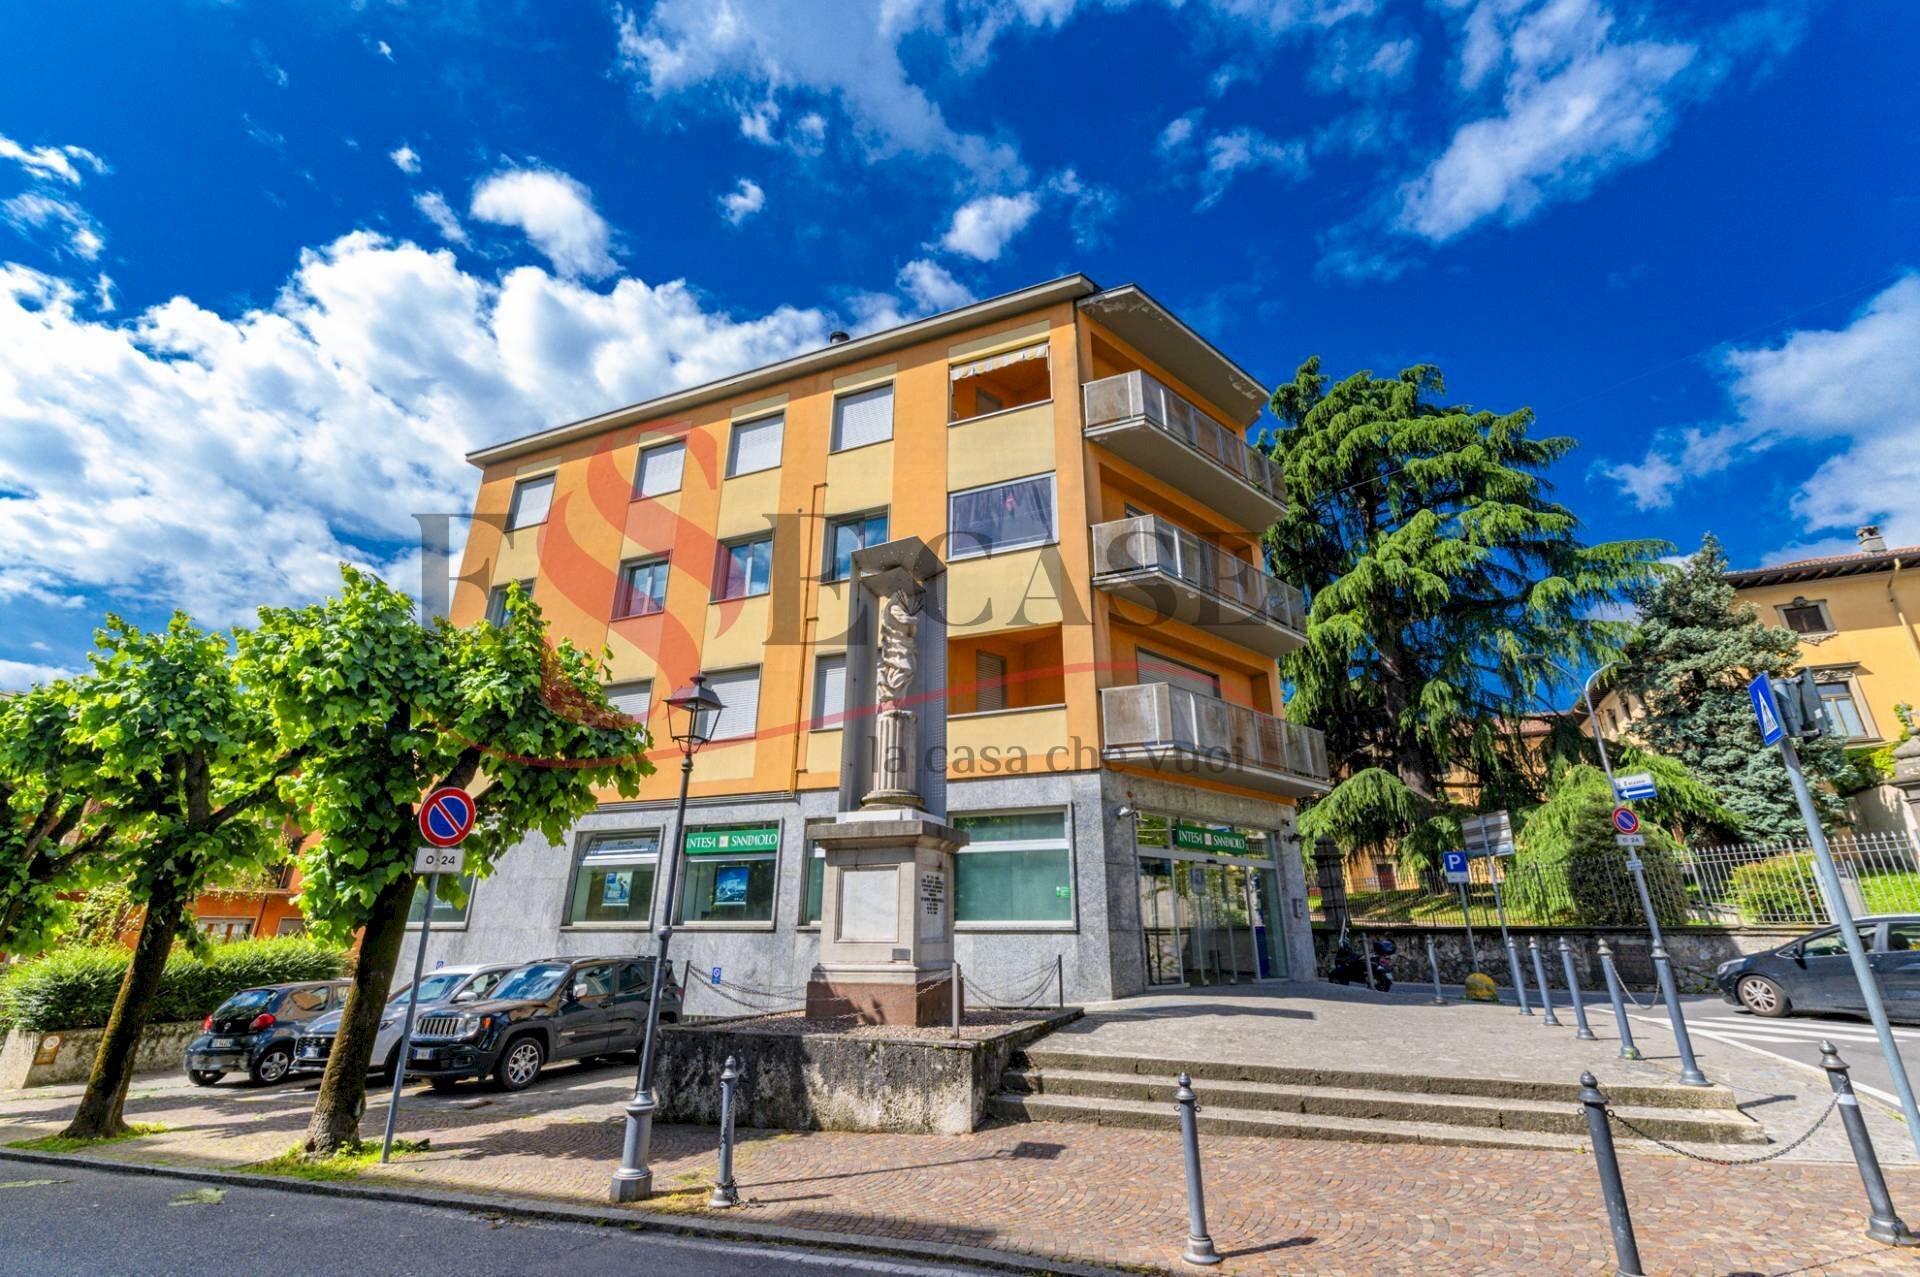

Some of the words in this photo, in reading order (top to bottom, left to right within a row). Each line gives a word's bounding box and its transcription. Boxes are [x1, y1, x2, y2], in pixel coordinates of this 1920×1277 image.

[686, 837, 716, 849] INTESA
[1179, 830, 1203, 844] INTESA
[1448, 854, 1461, 870] P
